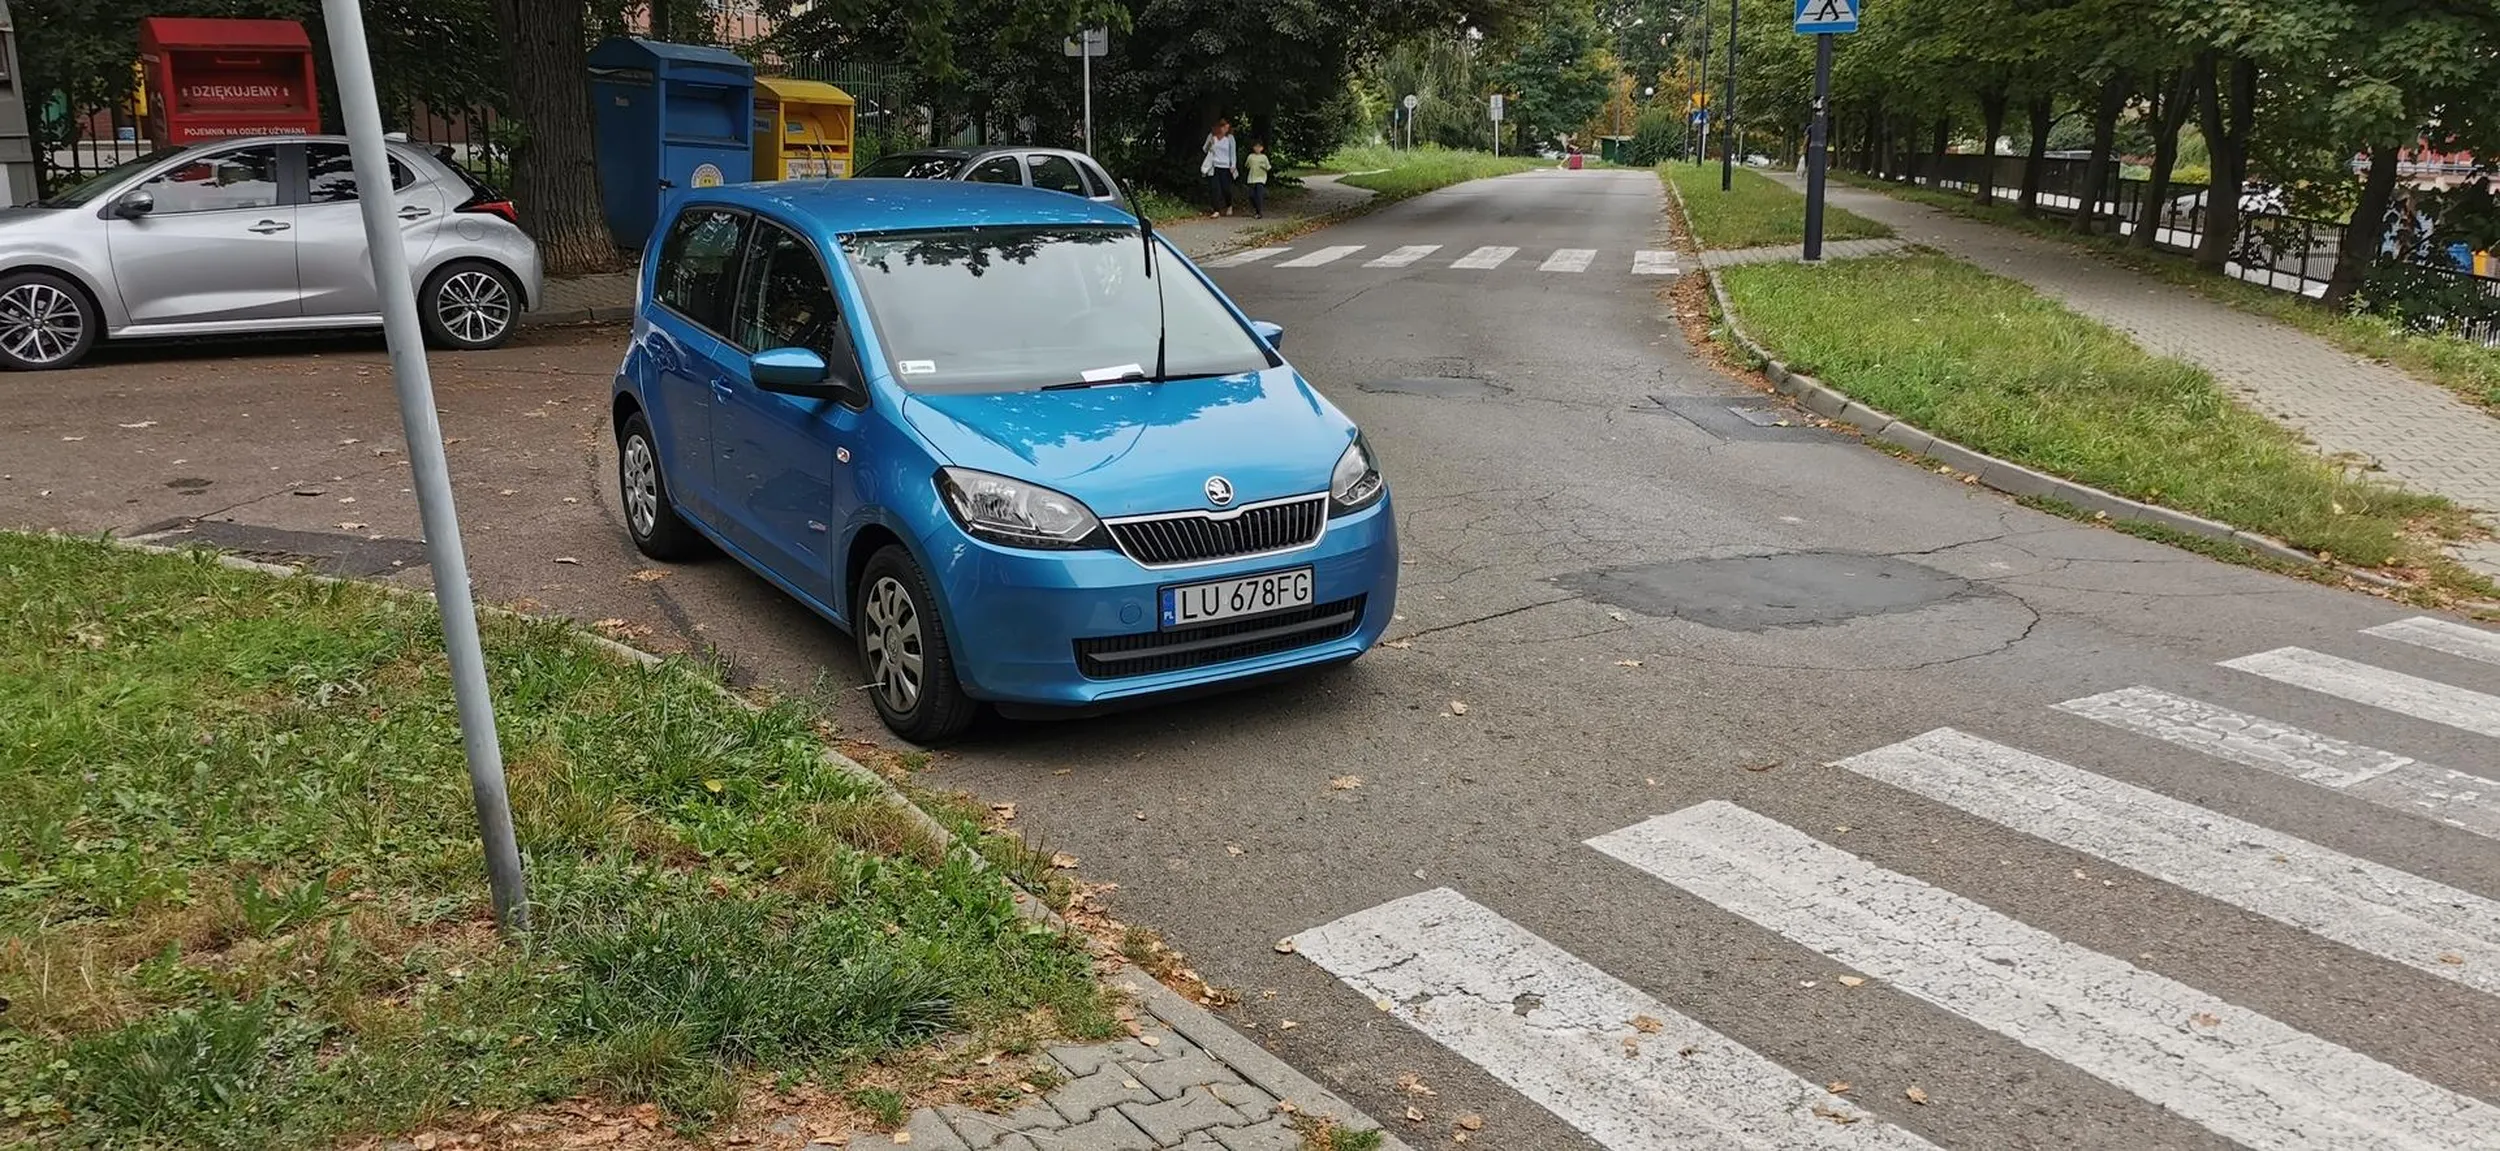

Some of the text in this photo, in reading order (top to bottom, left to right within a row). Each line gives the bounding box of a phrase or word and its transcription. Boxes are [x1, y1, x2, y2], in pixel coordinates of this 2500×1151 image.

[192, 85, 278, 100] DZIĘKUJEMY
[184, 127, 225, 136] POJEMNIK
[1182, 573, 1308, 620] LU 678FG
[1163, 611, 1175, 620] PL
